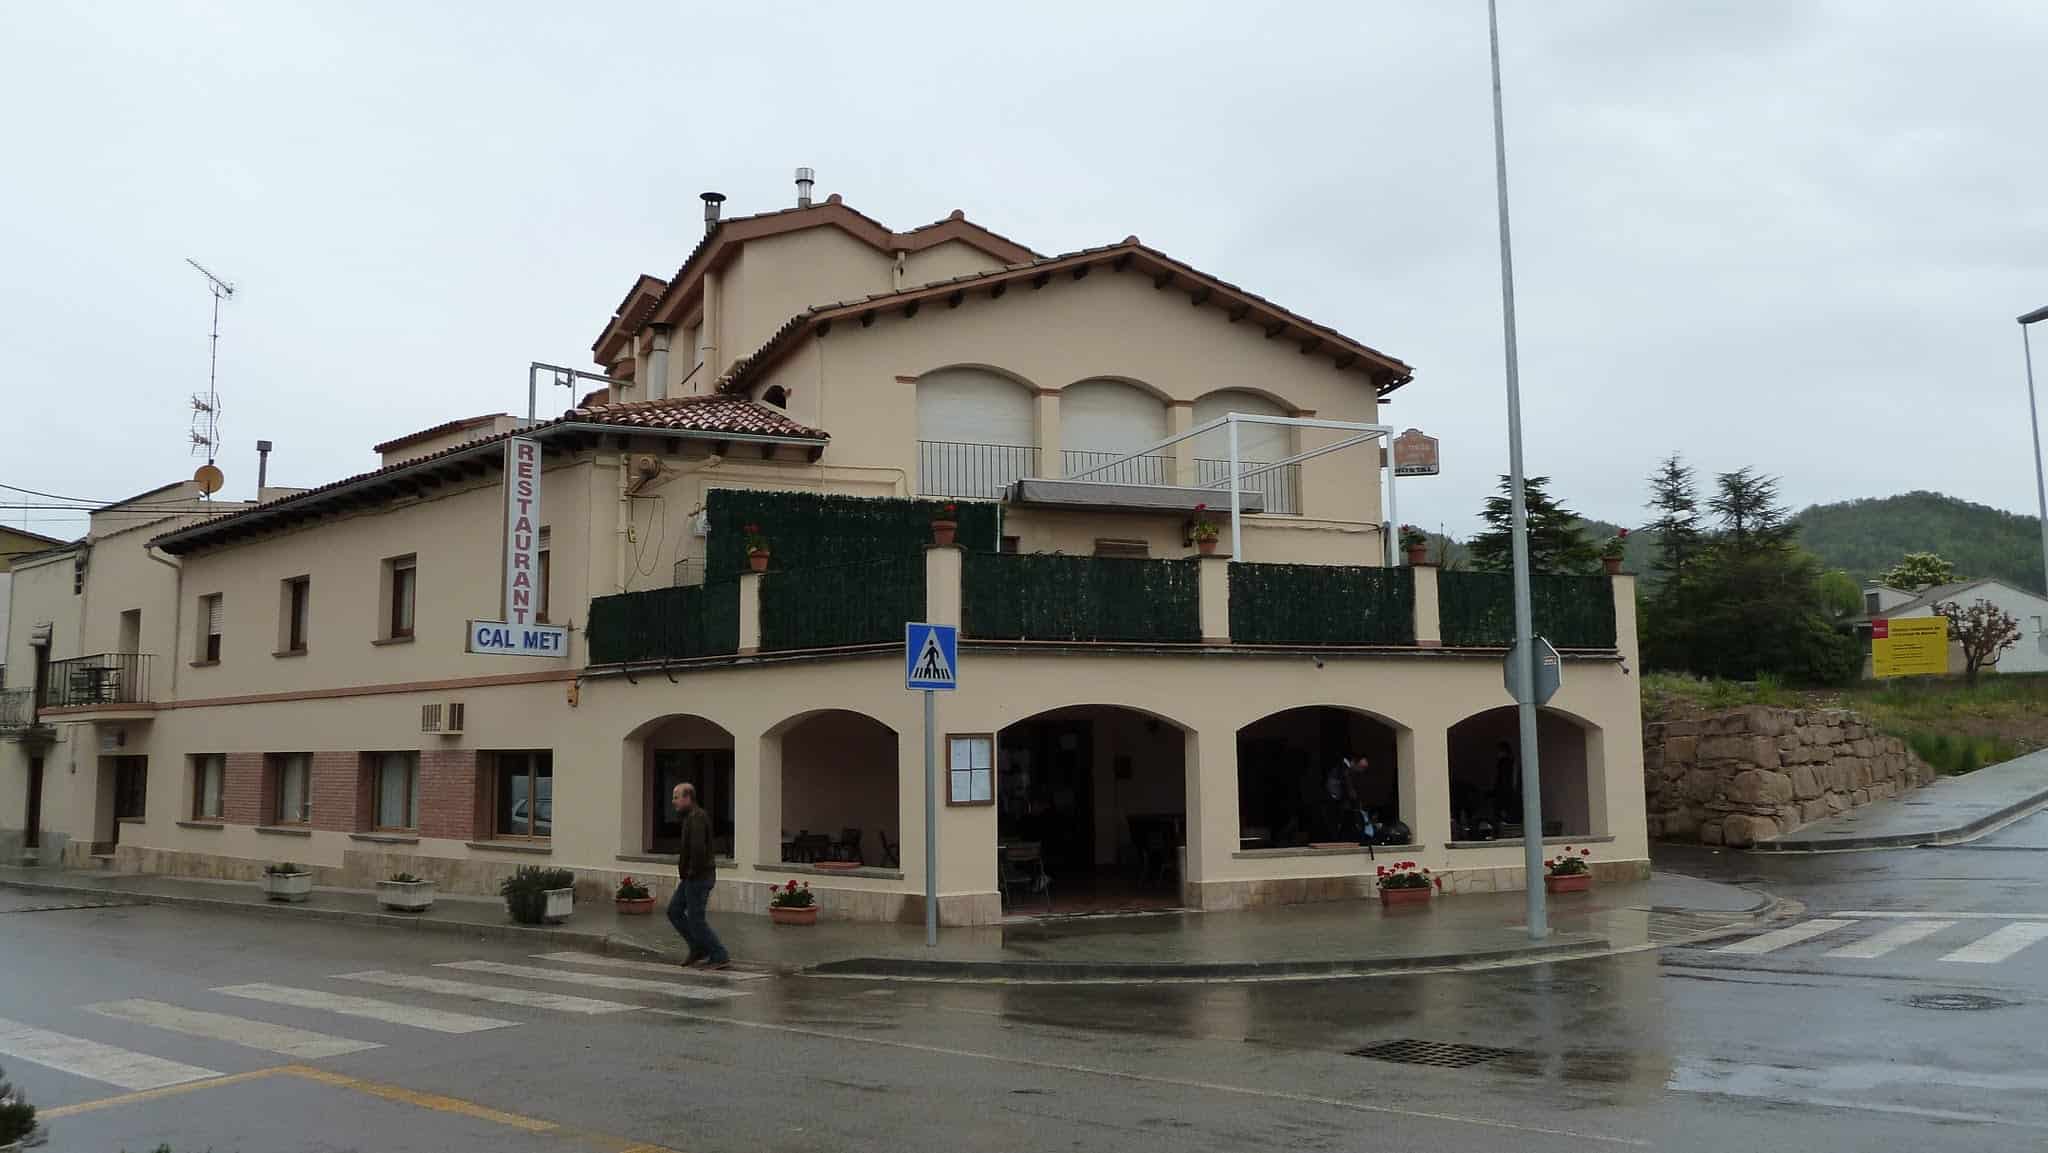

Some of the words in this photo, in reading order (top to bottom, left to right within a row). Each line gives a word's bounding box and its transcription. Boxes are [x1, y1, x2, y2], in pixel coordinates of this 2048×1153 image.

[513, 443, 534, 624] RESTAURANT
[477, 628, 515, 647] CAL
[524, 631, 562, 650] MET
